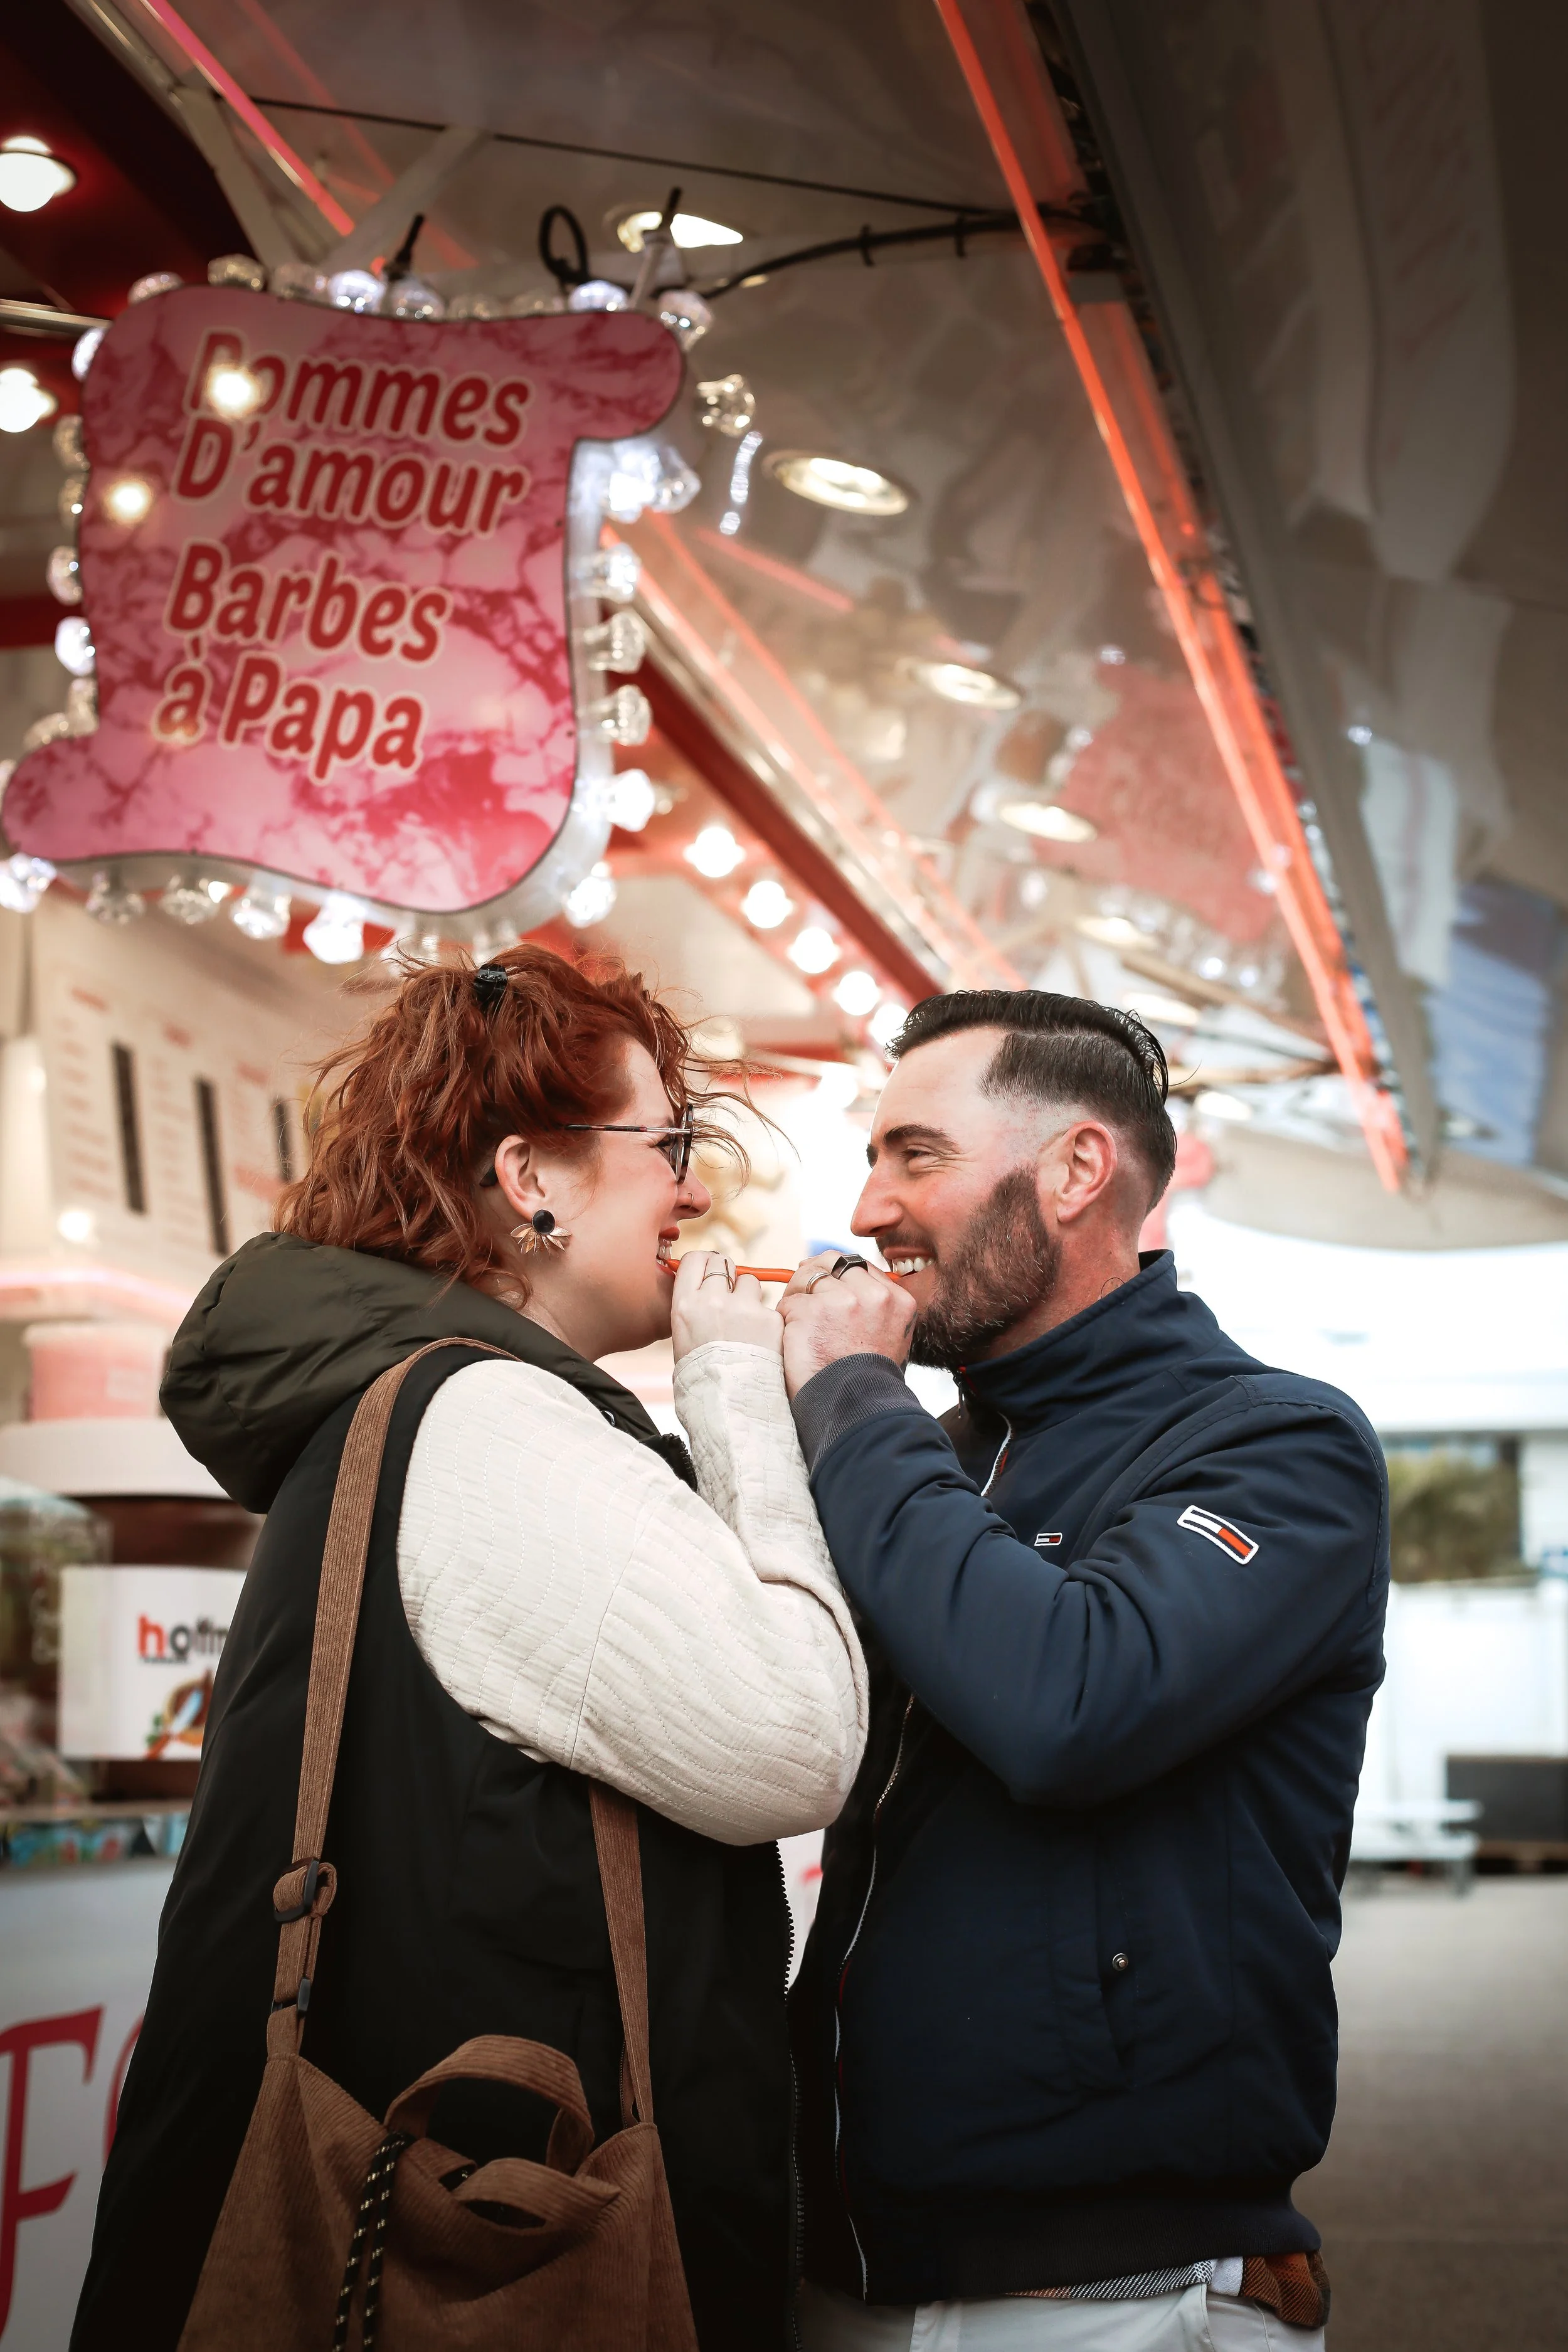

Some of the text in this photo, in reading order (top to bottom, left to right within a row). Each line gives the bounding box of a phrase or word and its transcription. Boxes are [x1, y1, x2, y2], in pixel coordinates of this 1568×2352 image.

[175, 415, 527, 534] D'amour
[169, 542, 448, 662] Barbes
[158, 635, 424, 781] à Papa
